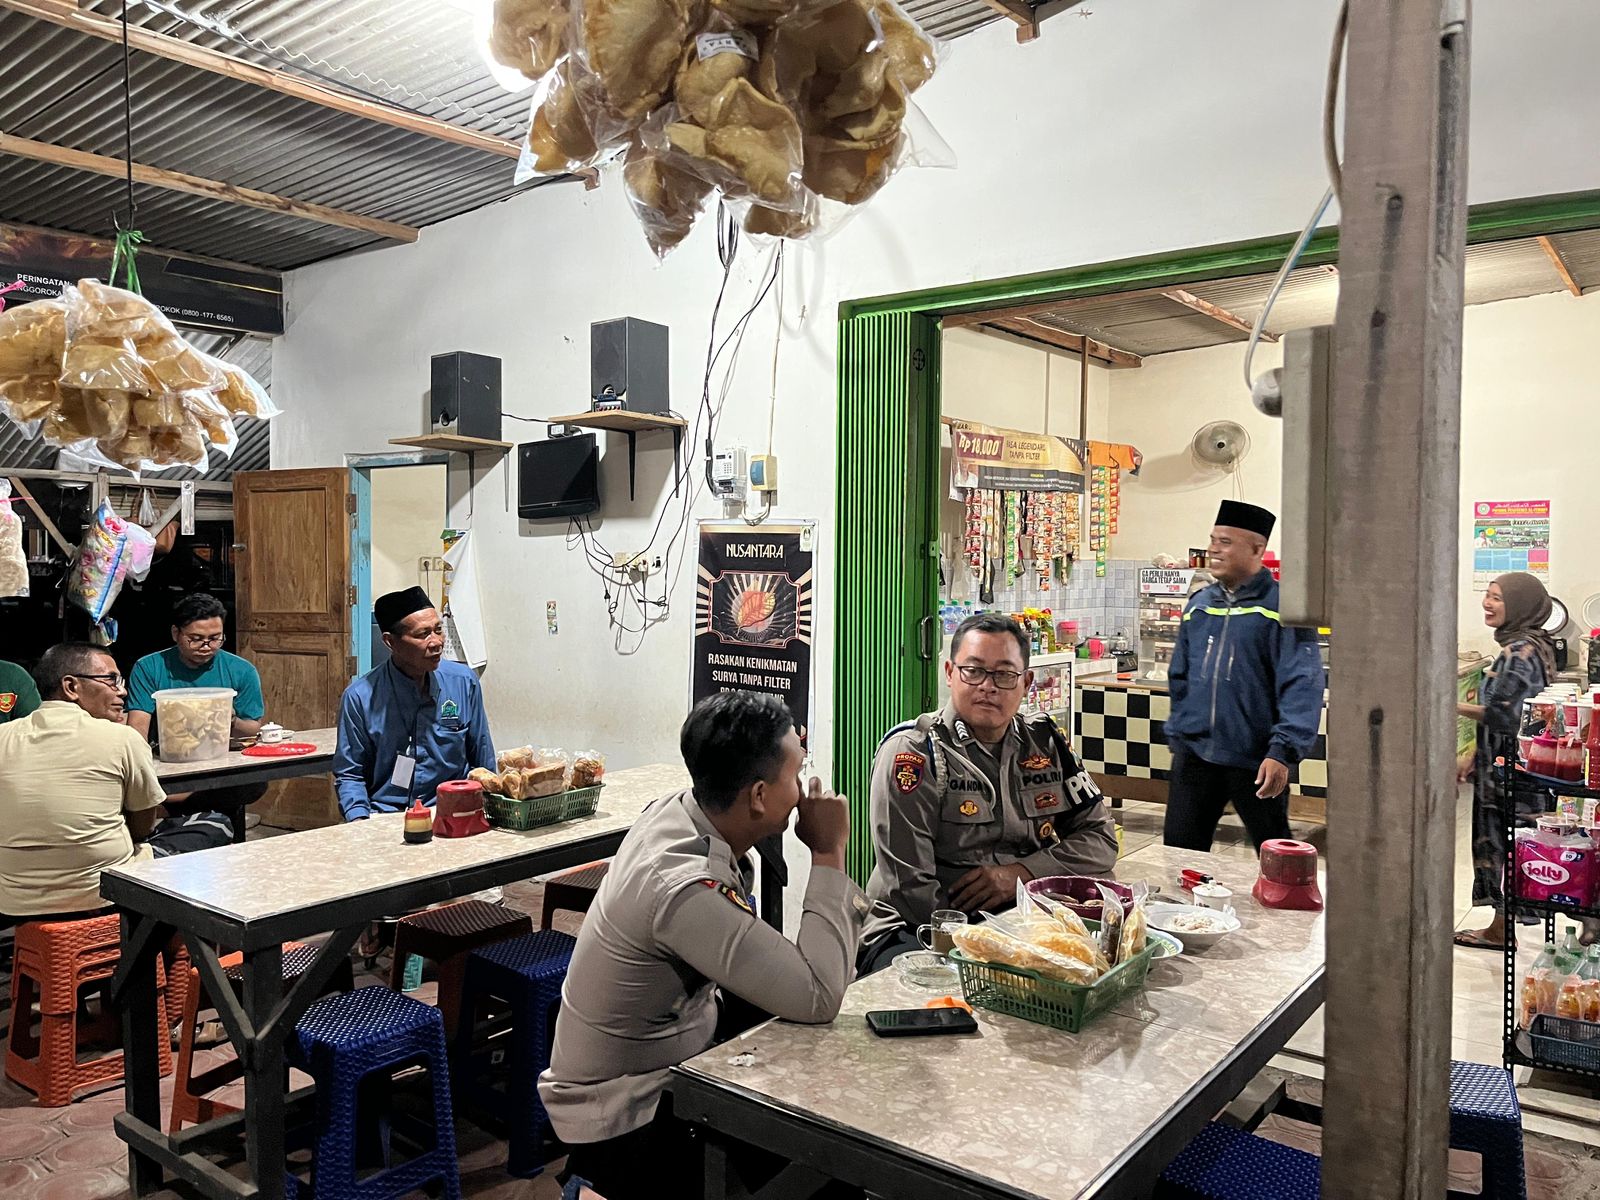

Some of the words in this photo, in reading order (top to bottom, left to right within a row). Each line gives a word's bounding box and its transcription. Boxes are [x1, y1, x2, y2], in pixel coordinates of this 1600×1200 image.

[726, 543, 784, 559] NUSANTARA
[708, 653, 745, 668] RASAKAN
[746, 656, 798, 673] KENIKMATAN
[712, 670, 738, 683] SURYA
[739, 673, 763, 687] TANPA
[764, 676, 791, 690] FILTER
[1022, 771, 1061, 786] POLRI
[1527, 862, 1563, 881] jolly
